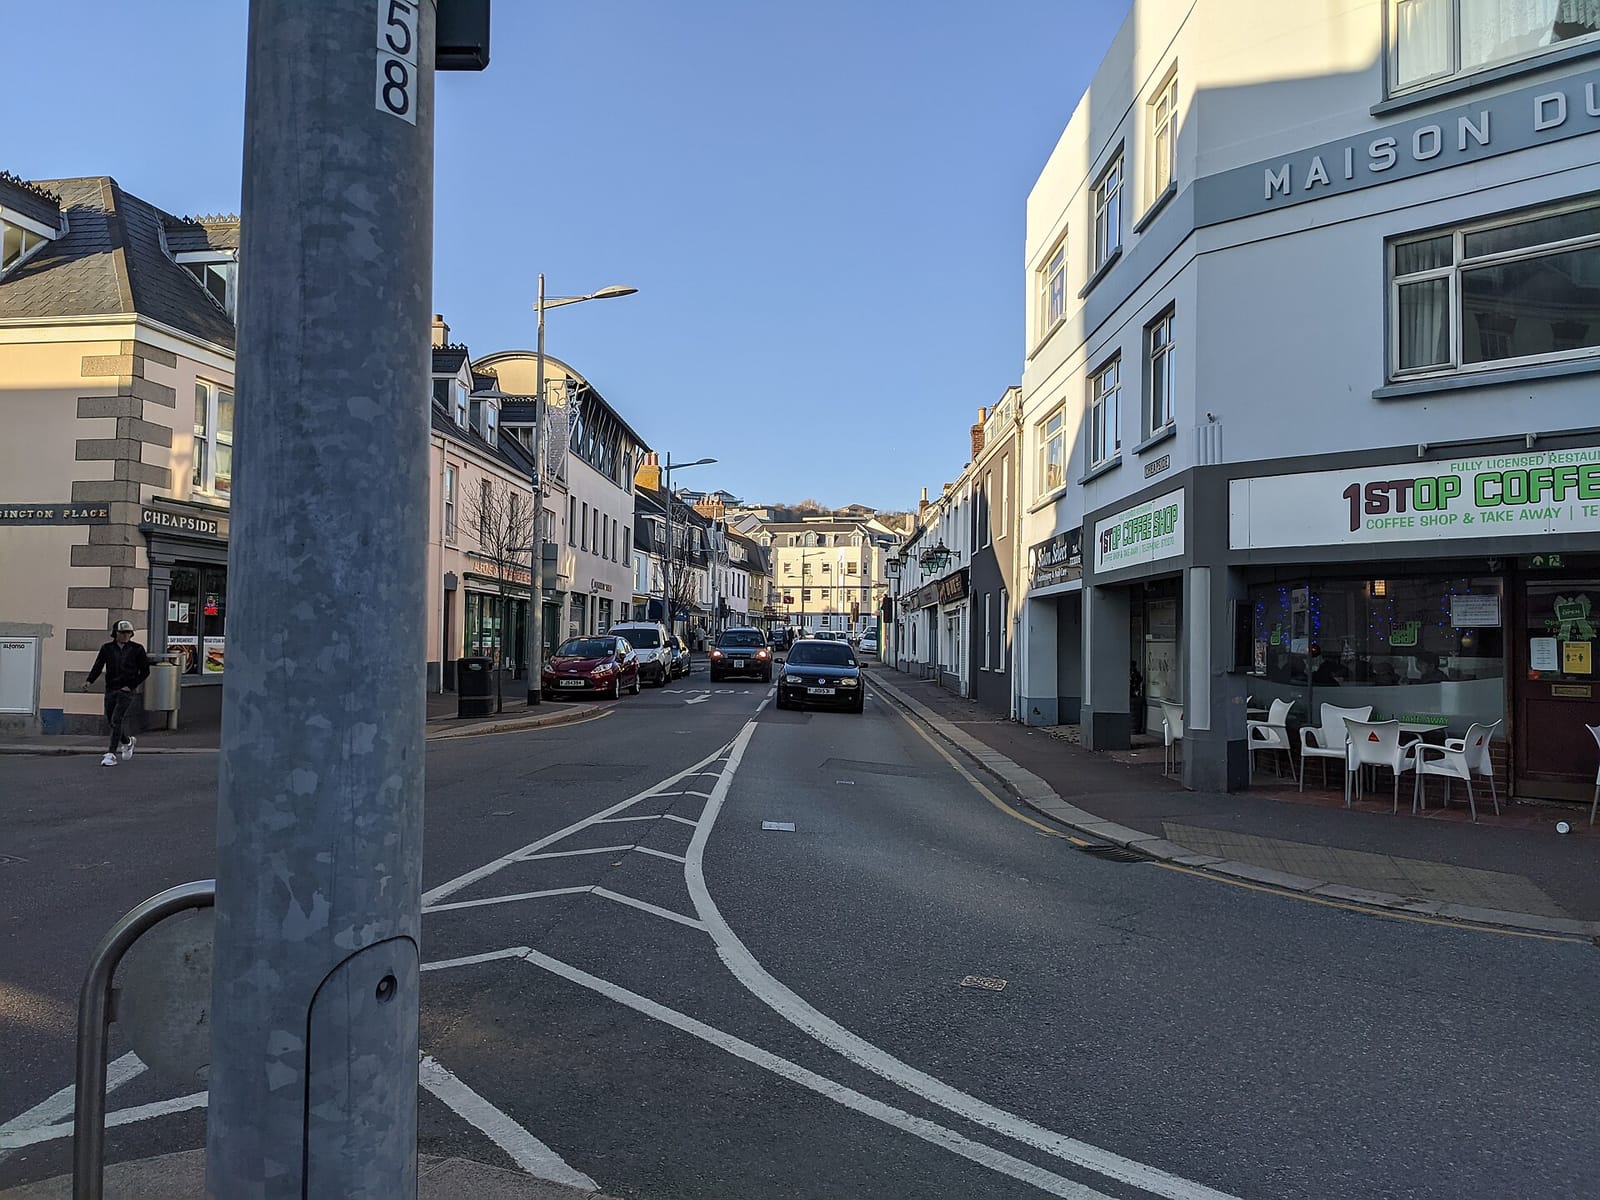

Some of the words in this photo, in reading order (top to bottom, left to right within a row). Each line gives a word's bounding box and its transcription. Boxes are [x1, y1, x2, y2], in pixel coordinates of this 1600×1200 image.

[1264, 110, 1491, 200] MAISON
[1450, 460, 1483, 473] FULLY
[1487, 455, 1545, 469] LICENSED
[1548, 450, 1600, 465] RESTAU
[63, 509, 108, 518] PLACE
[1343, 475, 1461, 532] 1STOP
[143, 510, 216, 534] CHEAPSIDE
[1122, 512, 1152, 546] COFFEE
[1153, 504, 1178, 538] SHOP
[1366, 516, 1416, 530] COFFEE
[1420, 513, 1458, 527] SHOP
[1463, 512, 1475, 525] &
[1480, 509, 1514, 523] TAKE
[1519, 506, 1562, 520] AWAY
